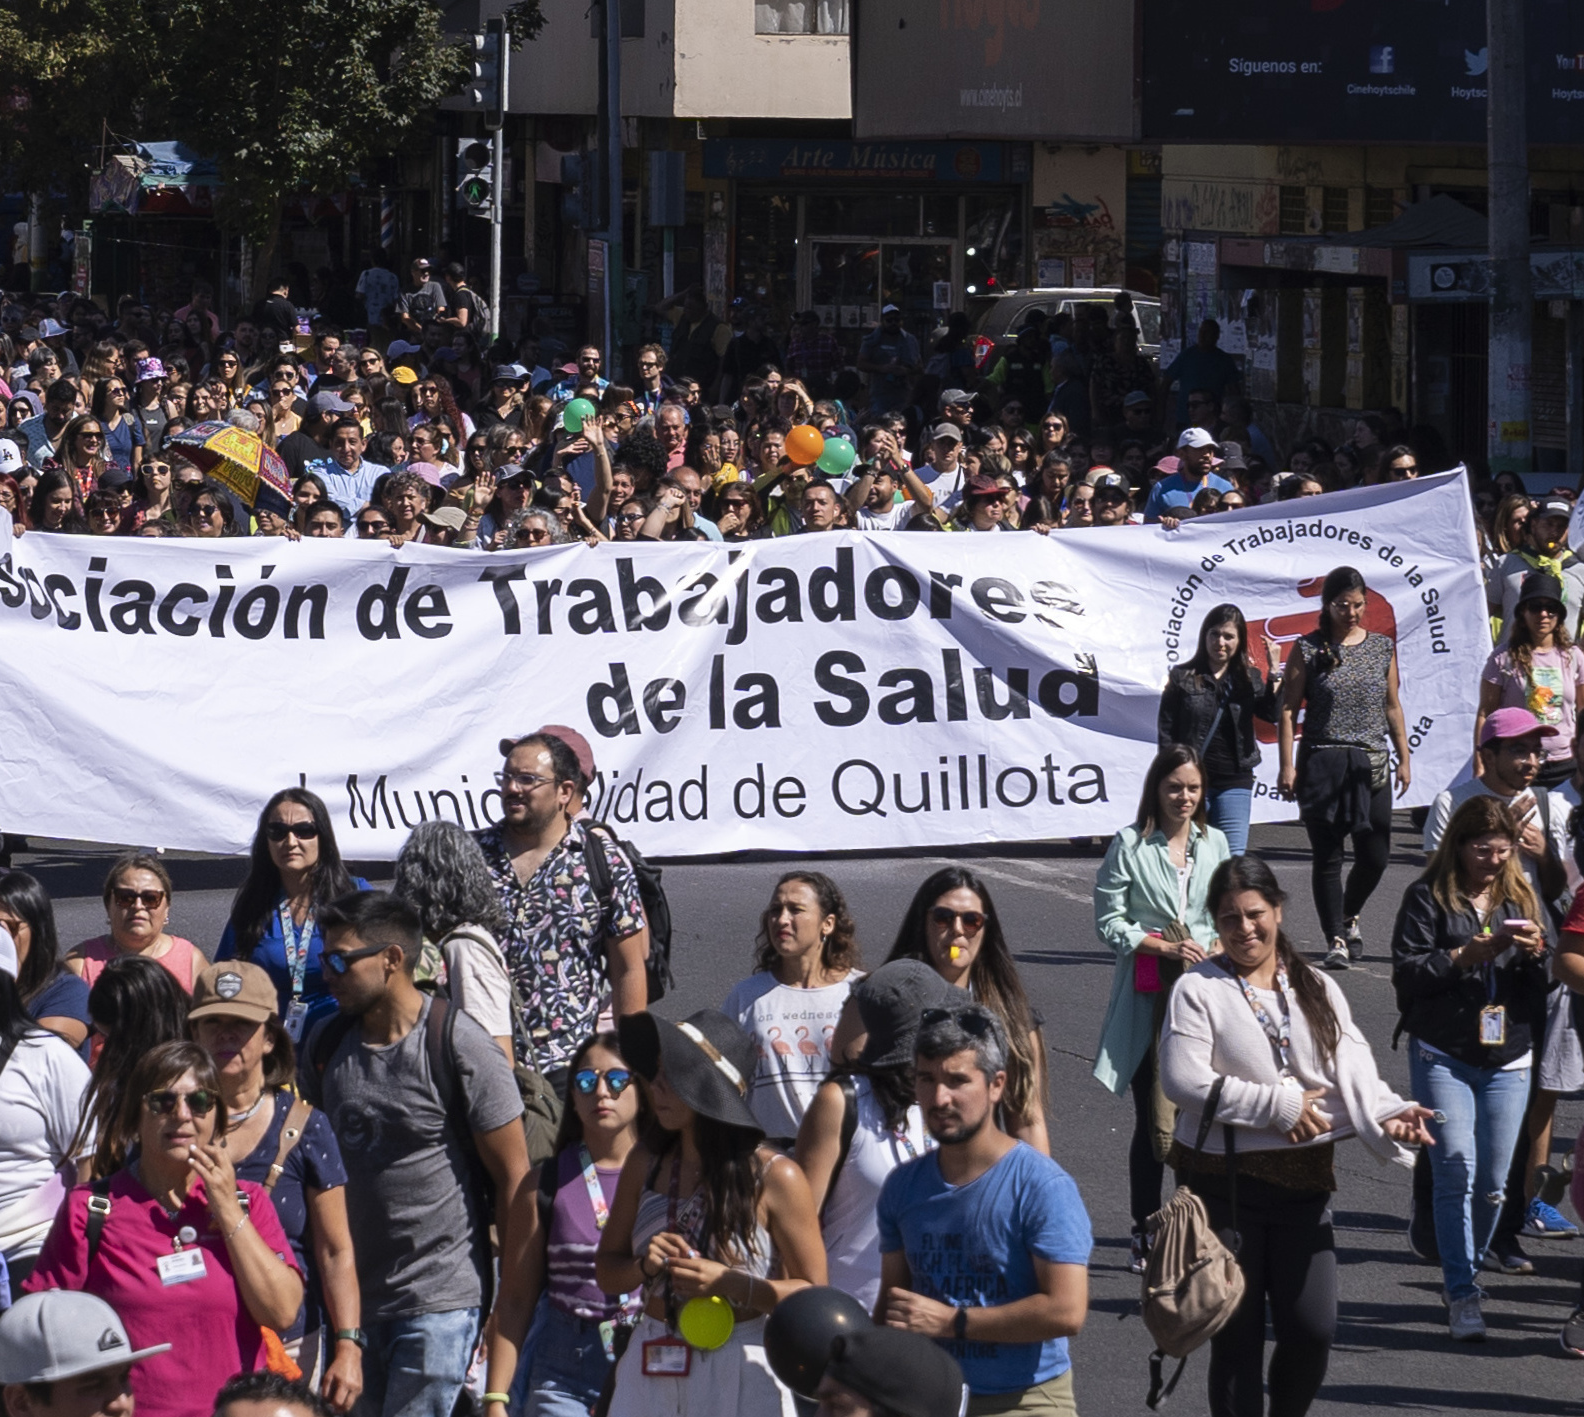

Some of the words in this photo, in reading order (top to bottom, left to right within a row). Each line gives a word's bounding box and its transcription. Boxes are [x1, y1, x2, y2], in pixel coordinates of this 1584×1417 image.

[1228, 56, 1296, 77] Síguenos
[1300, 60, 1324, 74] en:
[1346, 83, 1416, 97] Cinehoytschile
[780, 145, 834, 168] Arte
[846, 145, 937, 170] Música
[356, 563, 452, 640] de
[478, 546, 1086, 647] Trabajadores
[1200, 551, 1225, 574] de
[1222, 519, 1373, 558] Trabajadores
[1377, 543, 1405, 569] de
[1403, 564, 1424, 589] la
[1420, 587, 1451, 655] Salud
[586, 662, 688, 738] de
[709, 654, 782, 731] la
[813, 648, 1100, 729] Salud
[732, 762, 808, 820] de
[829, 752, 1110, 820] Quillota
[757, 1012, 774, 1023] on
